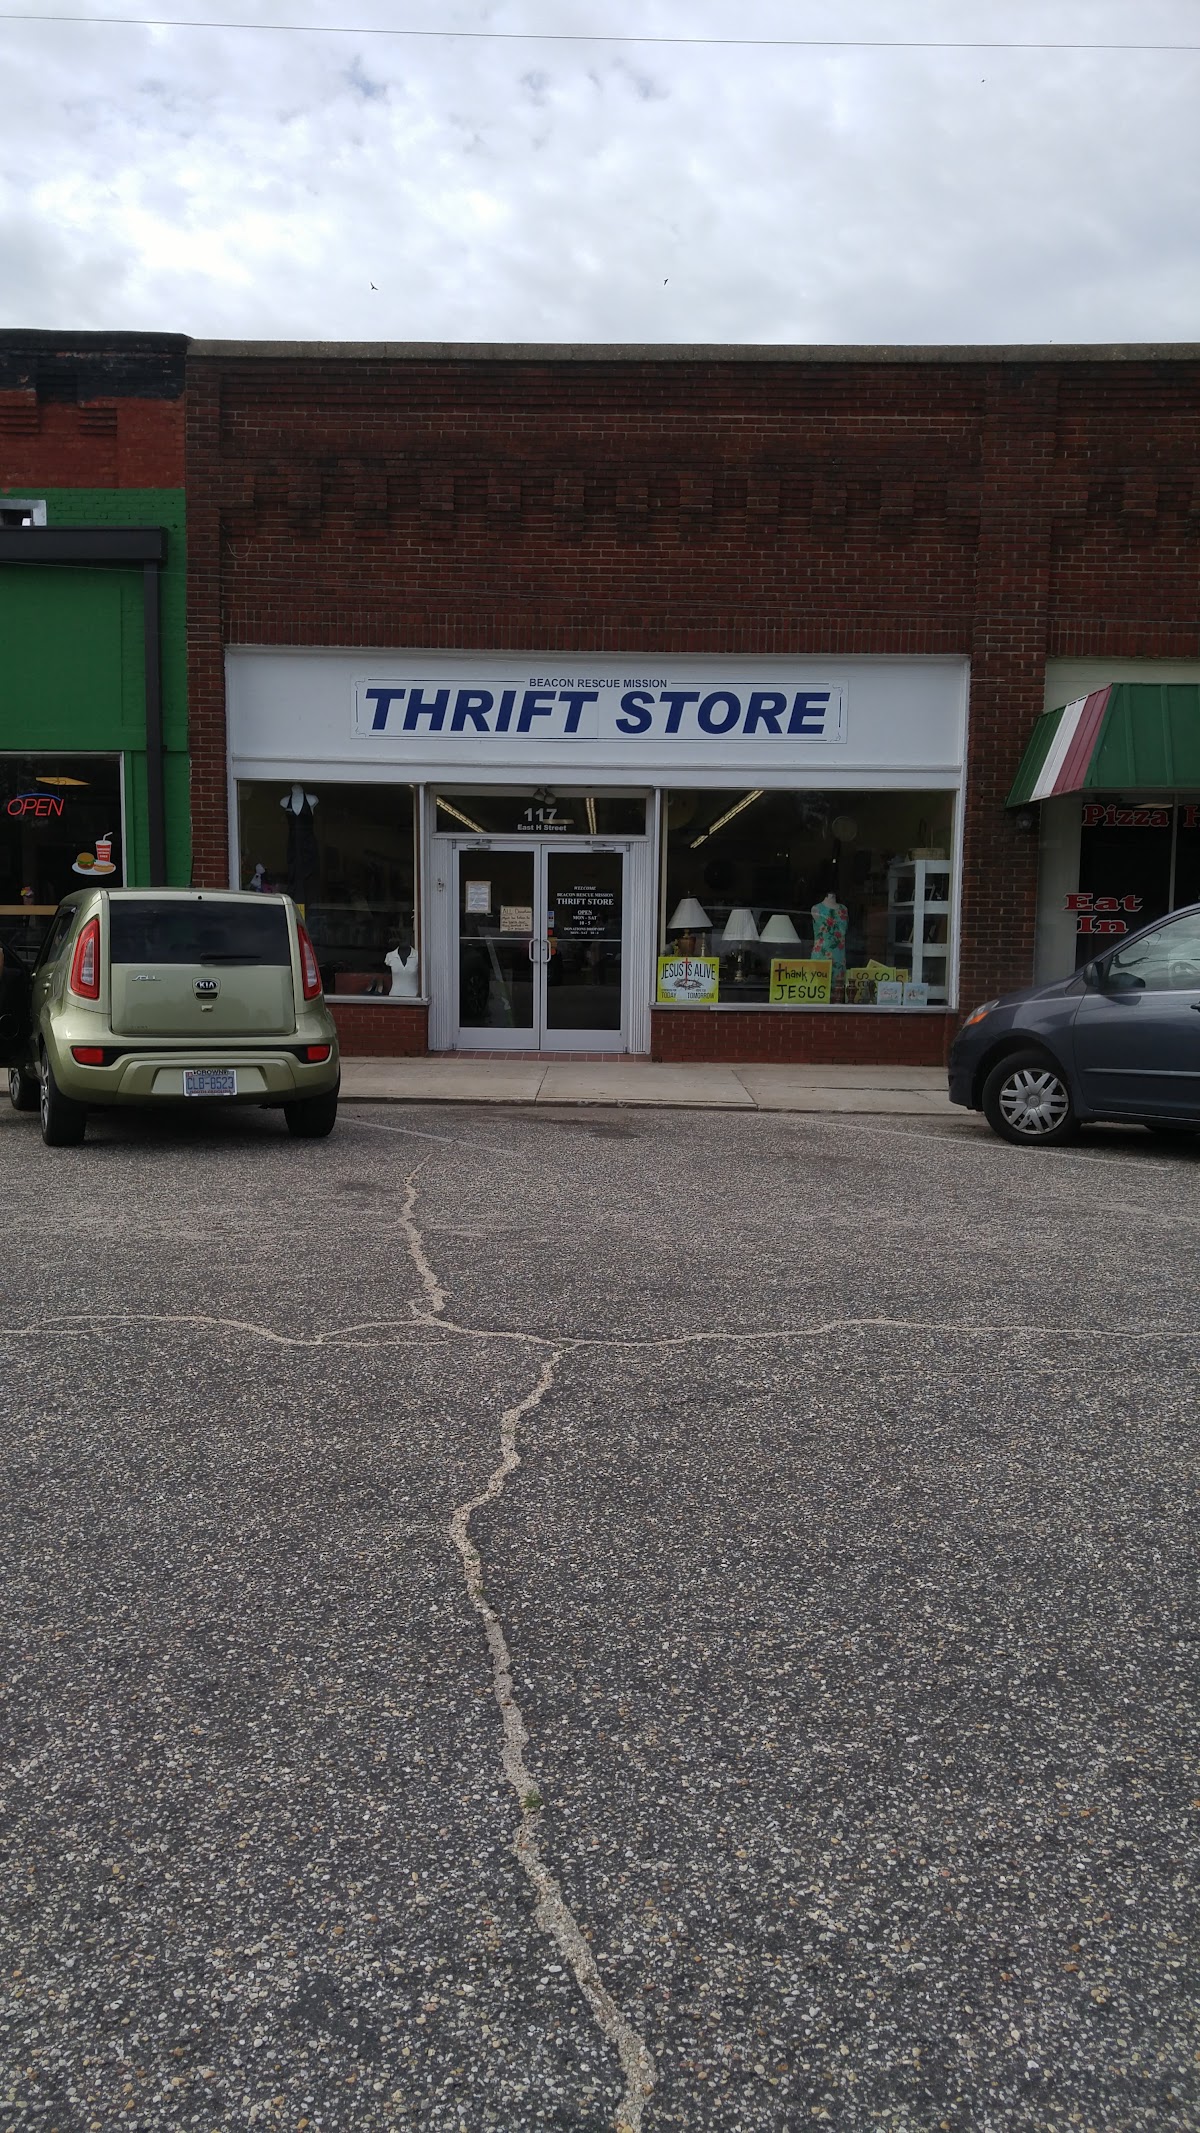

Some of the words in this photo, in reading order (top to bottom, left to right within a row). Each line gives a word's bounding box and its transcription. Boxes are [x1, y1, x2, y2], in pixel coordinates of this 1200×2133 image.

[529, 678, 574, 688] BEACON
[577, 678, 620, 688] RESCUE
[623, 679, 667, 688] MISSION
[366, 688, 599, 733] THRIFT
[616, 690, 831, 734] STORE
[7, 798, 64, 816] OPEN
[524, 808, 557, 822] 117
[1082, 804, 1170, 827] Pizza
[1064, 893, 1144, 912] Eat
[1076, 916, 1129, 933] In
[661, 964, 683, 980] JESUS
[694, 964, 716, 980] ALIVE
[810, 970, 827, 982] you
[774, 984, 826, 1000] JESUS
